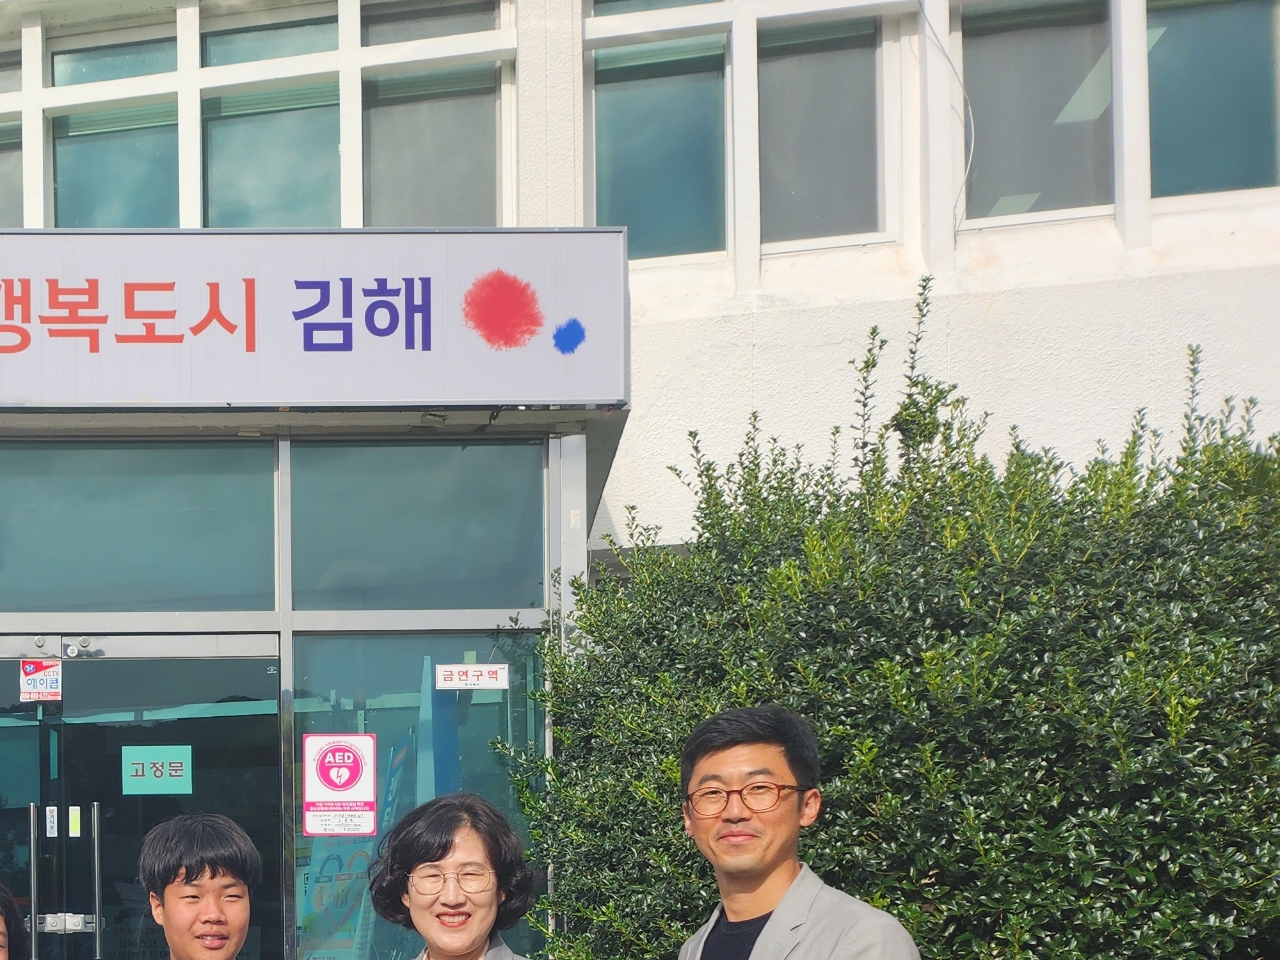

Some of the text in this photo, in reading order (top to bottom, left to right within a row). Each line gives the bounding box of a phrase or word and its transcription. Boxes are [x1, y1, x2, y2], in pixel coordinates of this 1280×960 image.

[291, 276, 432, 353] 김해
[442, 669, 498, 682] 금연구역
[26, 677, 59, 689] 에이콤
[324, 752, 354, 764] AED
[130, 761, 184, 779] 고정문
